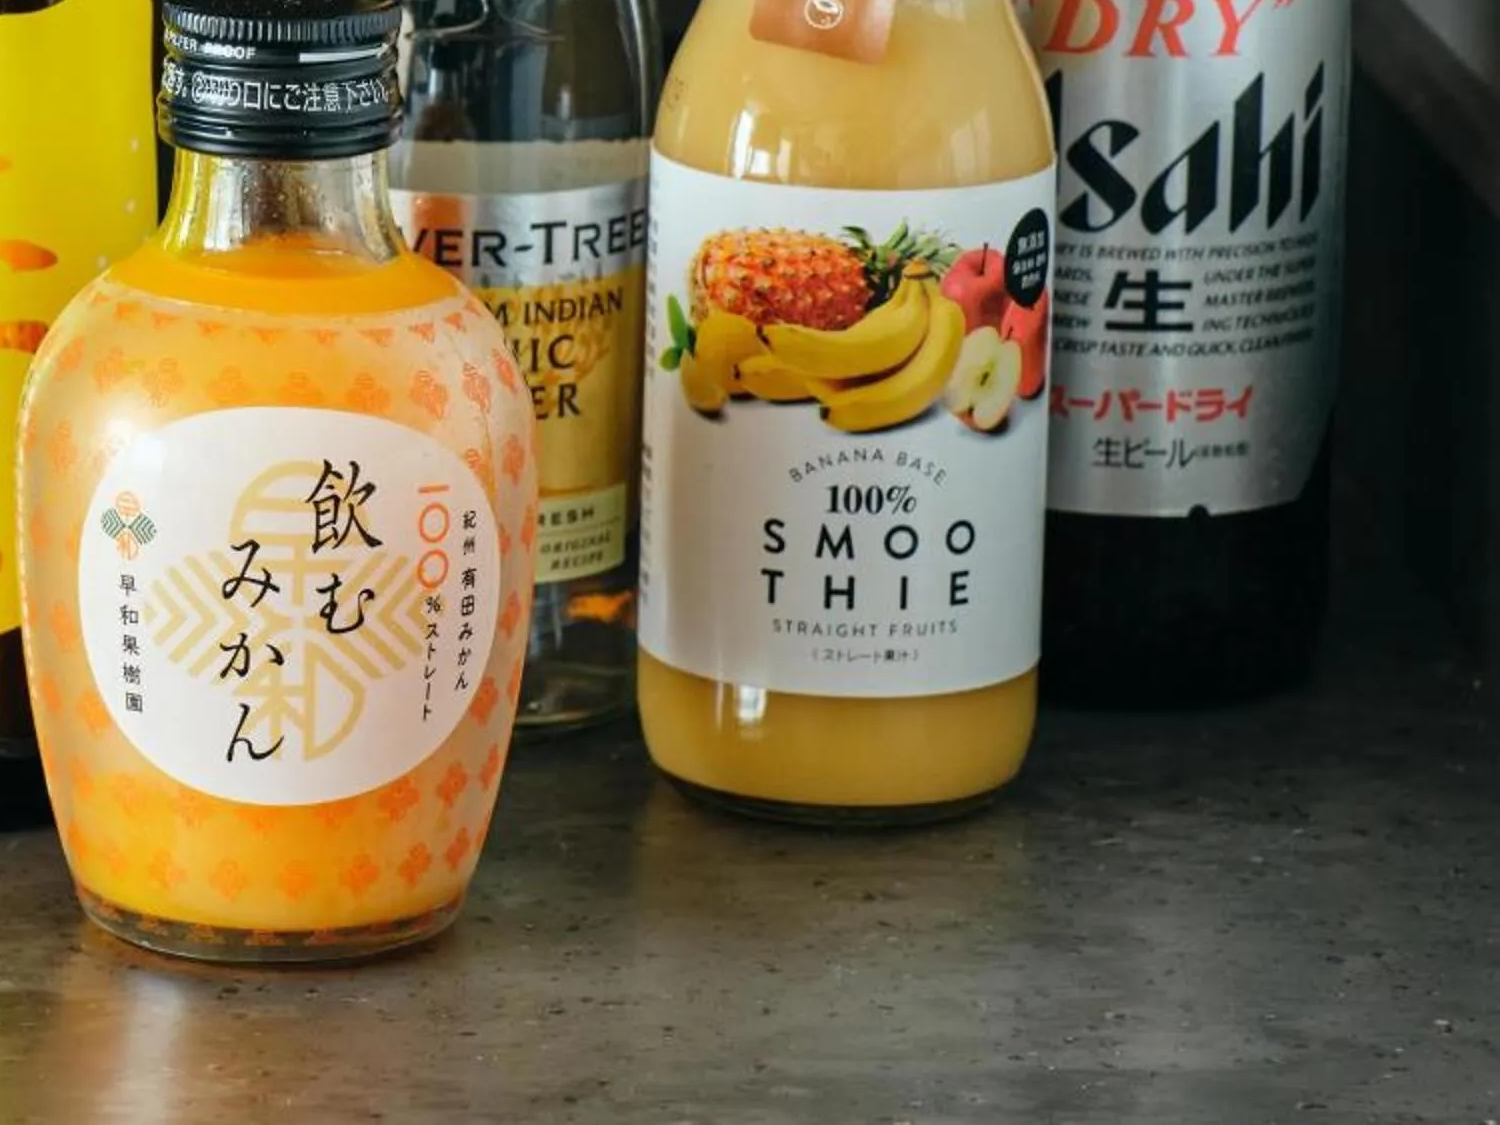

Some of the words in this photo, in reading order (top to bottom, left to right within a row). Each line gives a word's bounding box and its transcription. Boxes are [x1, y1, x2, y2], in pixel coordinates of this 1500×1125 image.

[1098, 245, 1161, 263] BREWED
[1164, 246, 1205, 263] WITH
[524, 288, 623, 325] INDIAN
[1103, 269, 1194, 332] 生
[1100, 339, 1147, 359] TASTE
[1149, 341, 1186, 357] AND
[788, 448, 884, 483] BANANA
[896, 451, 948, 487] BASE
[826, 484, 918, 515] 100%
[304, 458, 383, 635] 飲む
[762, 518, 976, 560] SMOO
[760, 568, 970, 611] THIE
[772, 618, 878, 638] STRAIGHT
[888, 619, 959, 637] FRUITS
[220, 538, 285, 763] みかん
